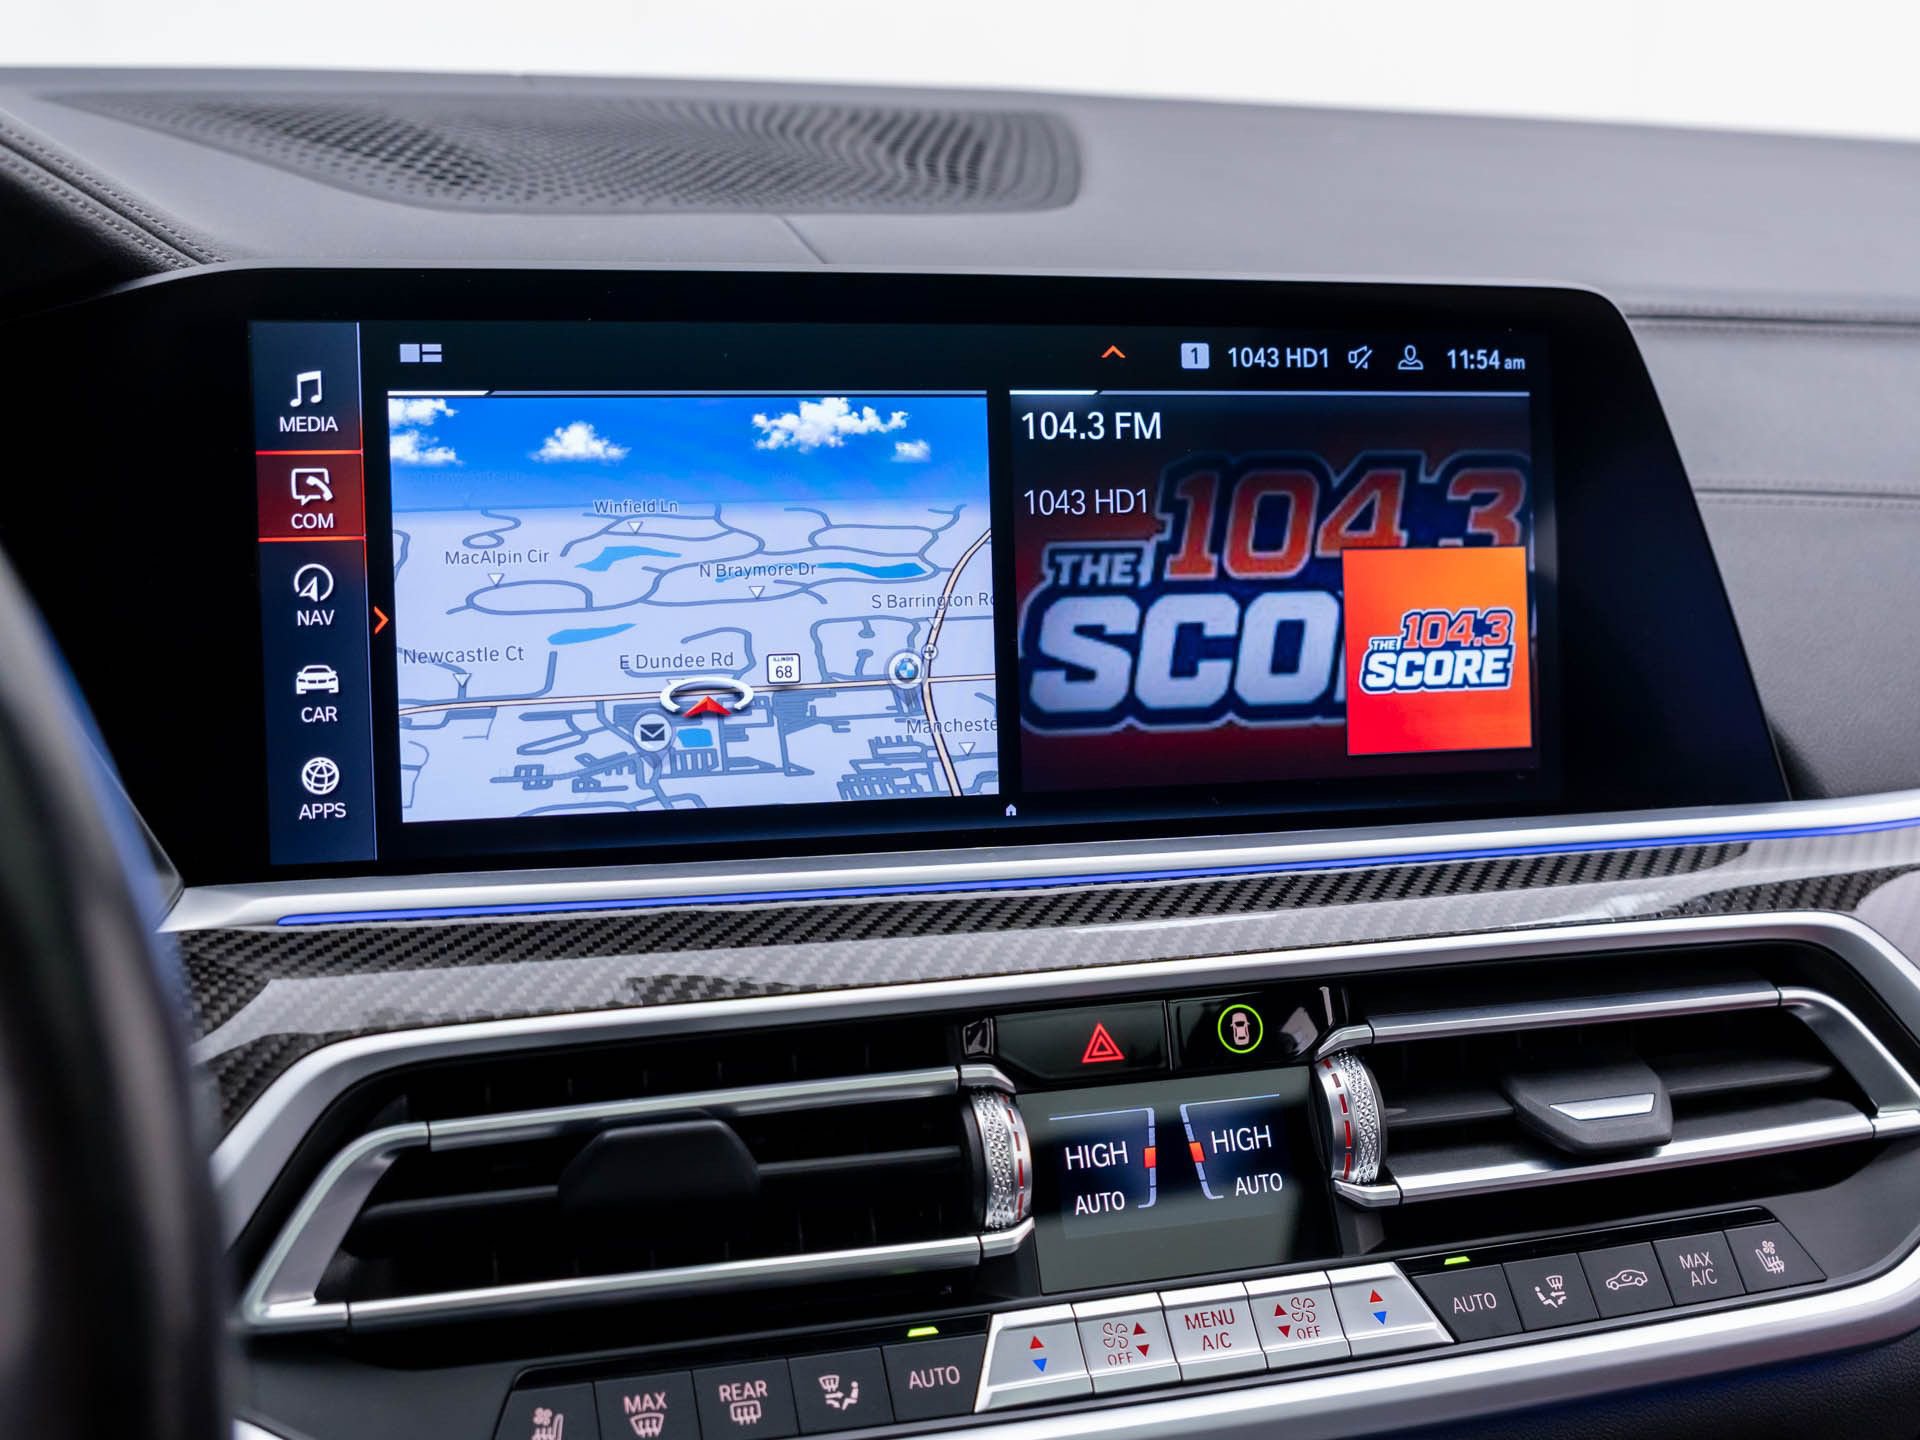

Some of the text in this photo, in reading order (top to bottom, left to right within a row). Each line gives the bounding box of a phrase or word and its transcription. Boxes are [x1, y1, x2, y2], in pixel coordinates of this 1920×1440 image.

[1189, 346, 1201, 366] 1
[1227, 347, 1329, 369] 1043 HD1
[1446, 349, 1526, 371] 11:54 am
[279, 416, 339, 433] MEDIA
[1021, 411, 1163, 440] 104.3 FM
[593, 499, 679, 514] Winfield Ln
[1023, 488, 1149, 515] 1043 HD1
[290, 513, 335, 530] COM
[444, 549, 550, 567] MacAlpin Cir
[699, 562, 817, 579] N Braymore Dr
[1055, 550, 1139, 587] THE
[871, 594, 882, 609] S
[887, 593, 973, 610] Barrington
[296, 609, 335, 626] NAV
[1403, 611, 1511, 649] 104.3
[403, 645, 525, 665] Newcastle Ct
[1371, 639, 1397, 651] THE
[619, 651, 735, 671] E Dundee Rd
[1364, 649, 1510, 688] SCORE
[775, 665, 793, 679] 68
[300, 706, 338, 723] CAR
[299, 802, 347, 820] APPS
[1210, 1124, 1273, 1154] HIGH
[1064, 1140, 1129, 1171] HIGH
[1234, 1172, 1284, 1197] AUTO
[1074, 1190, 1126, 1216] AUTO
[1679, 1251, 1714, 1271] MAX
[1690, 1268, 1719, 1288] A/C
[1452, 1292, 1498, 1315] AUTO
[1184, 1307, 1236, 1331] MENU
[1202, 1331, 1233, 1351] A/C
[1296, 1324, 1322, 1340] OFF
[1107, 1350, 1134, 1366] OFF
[908, 1365, 961, 1390] AUTO
[718, 1380, 769, 1403] REAR
[624, 1392, 668, 1415] MAX
